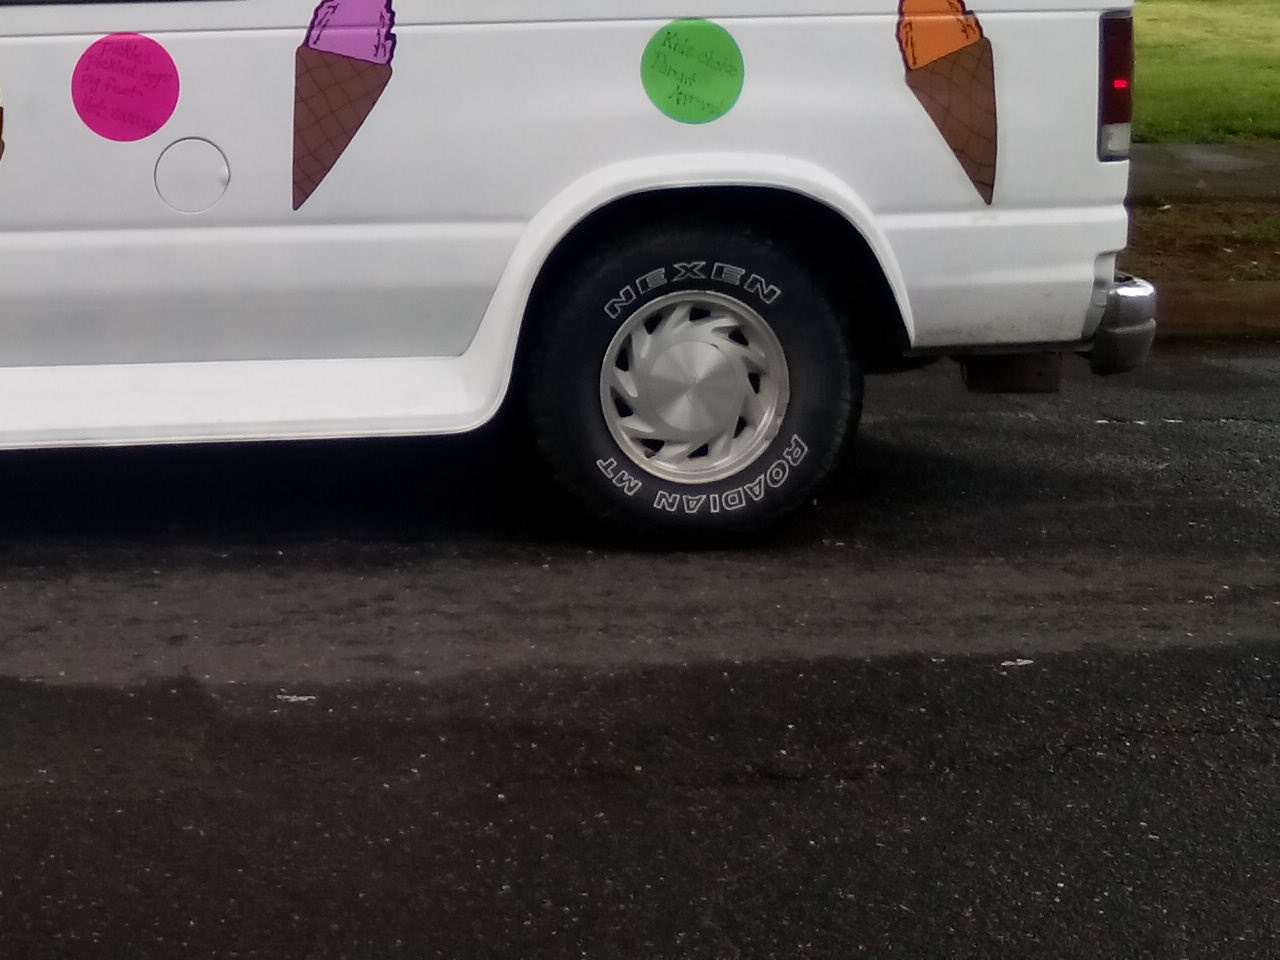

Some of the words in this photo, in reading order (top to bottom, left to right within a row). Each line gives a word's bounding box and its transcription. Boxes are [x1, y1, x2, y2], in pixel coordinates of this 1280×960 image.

[604, 260, 782, 320] NEXEN
[596, 455, 644, 497] MT
[653, 433, 809, 514] ROADIAN
